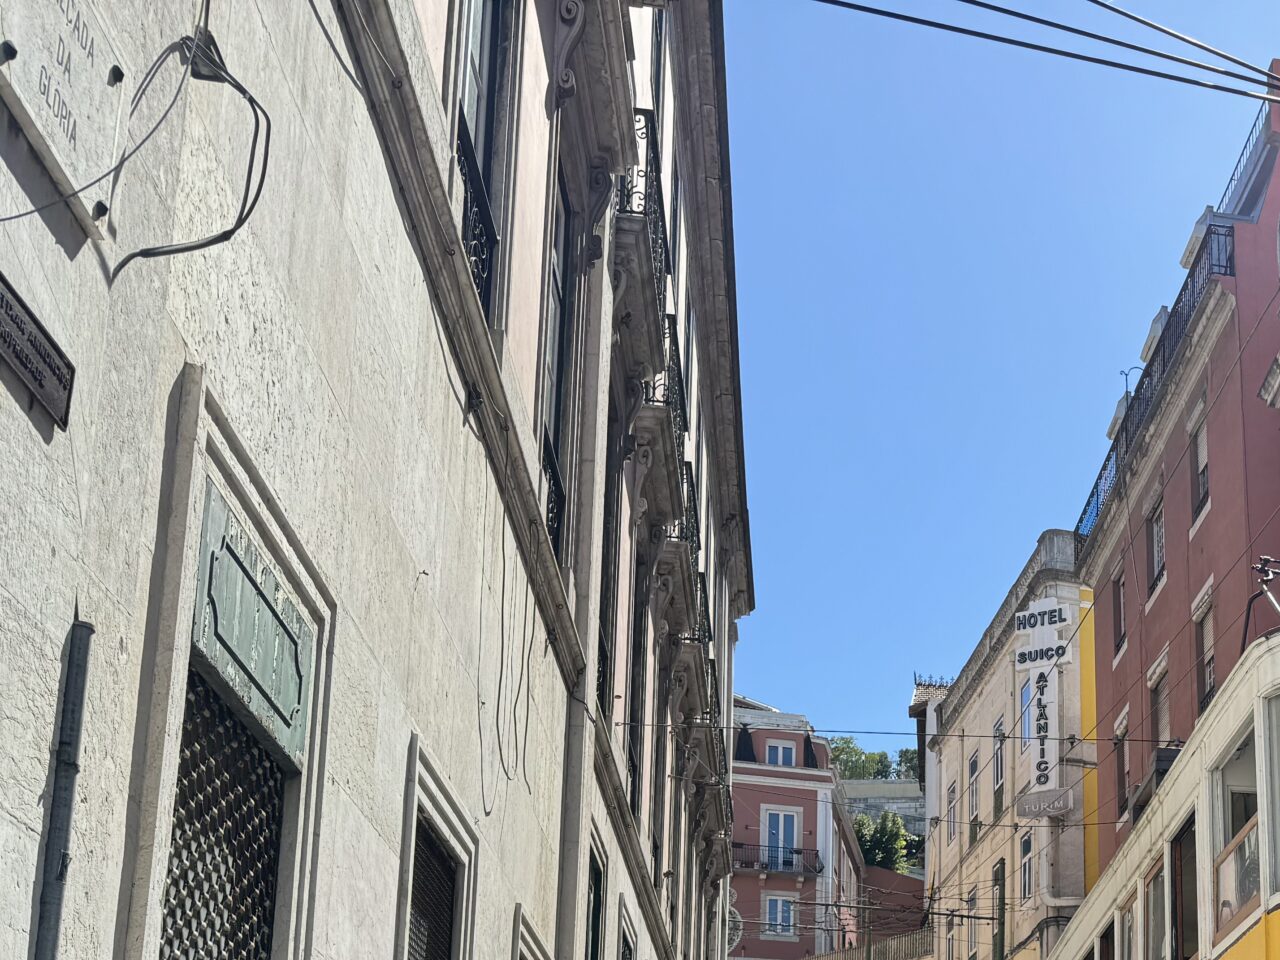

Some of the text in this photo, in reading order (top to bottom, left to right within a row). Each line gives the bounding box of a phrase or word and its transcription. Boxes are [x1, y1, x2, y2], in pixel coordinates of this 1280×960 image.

[56, 34, 71, 86] DA
[39, 65, 77, 151] GLÓRIA
[1016, 607, 1067, 631] HOTEL
[1023, 799, 1064, 813] TURIM
